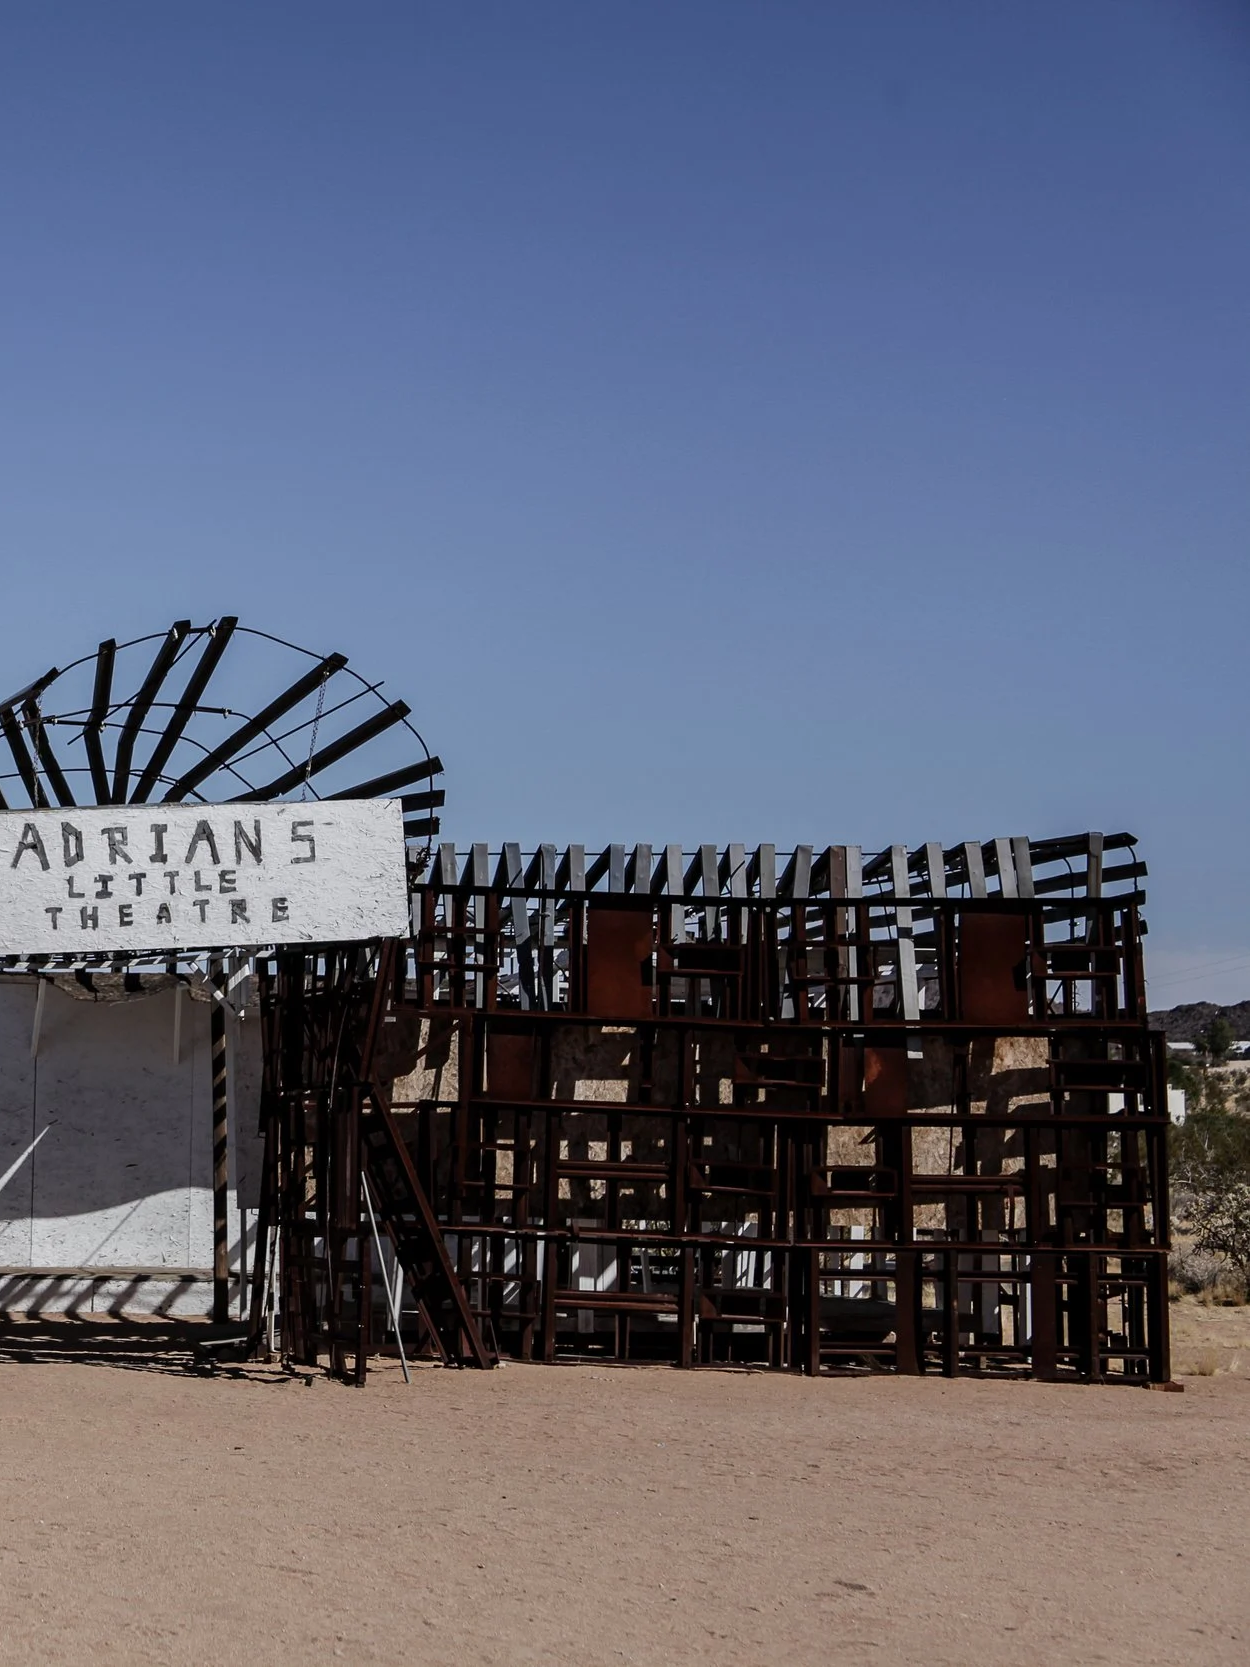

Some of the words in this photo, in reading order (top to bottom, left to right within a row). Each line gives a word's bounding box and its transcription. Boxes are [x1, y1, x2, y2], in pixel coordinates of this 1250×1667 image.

[10, 820, 316, 871] ADRIANS
[68, 869, 237, 899] LITTLE
[45, 897, 290, 930] THEATRE
